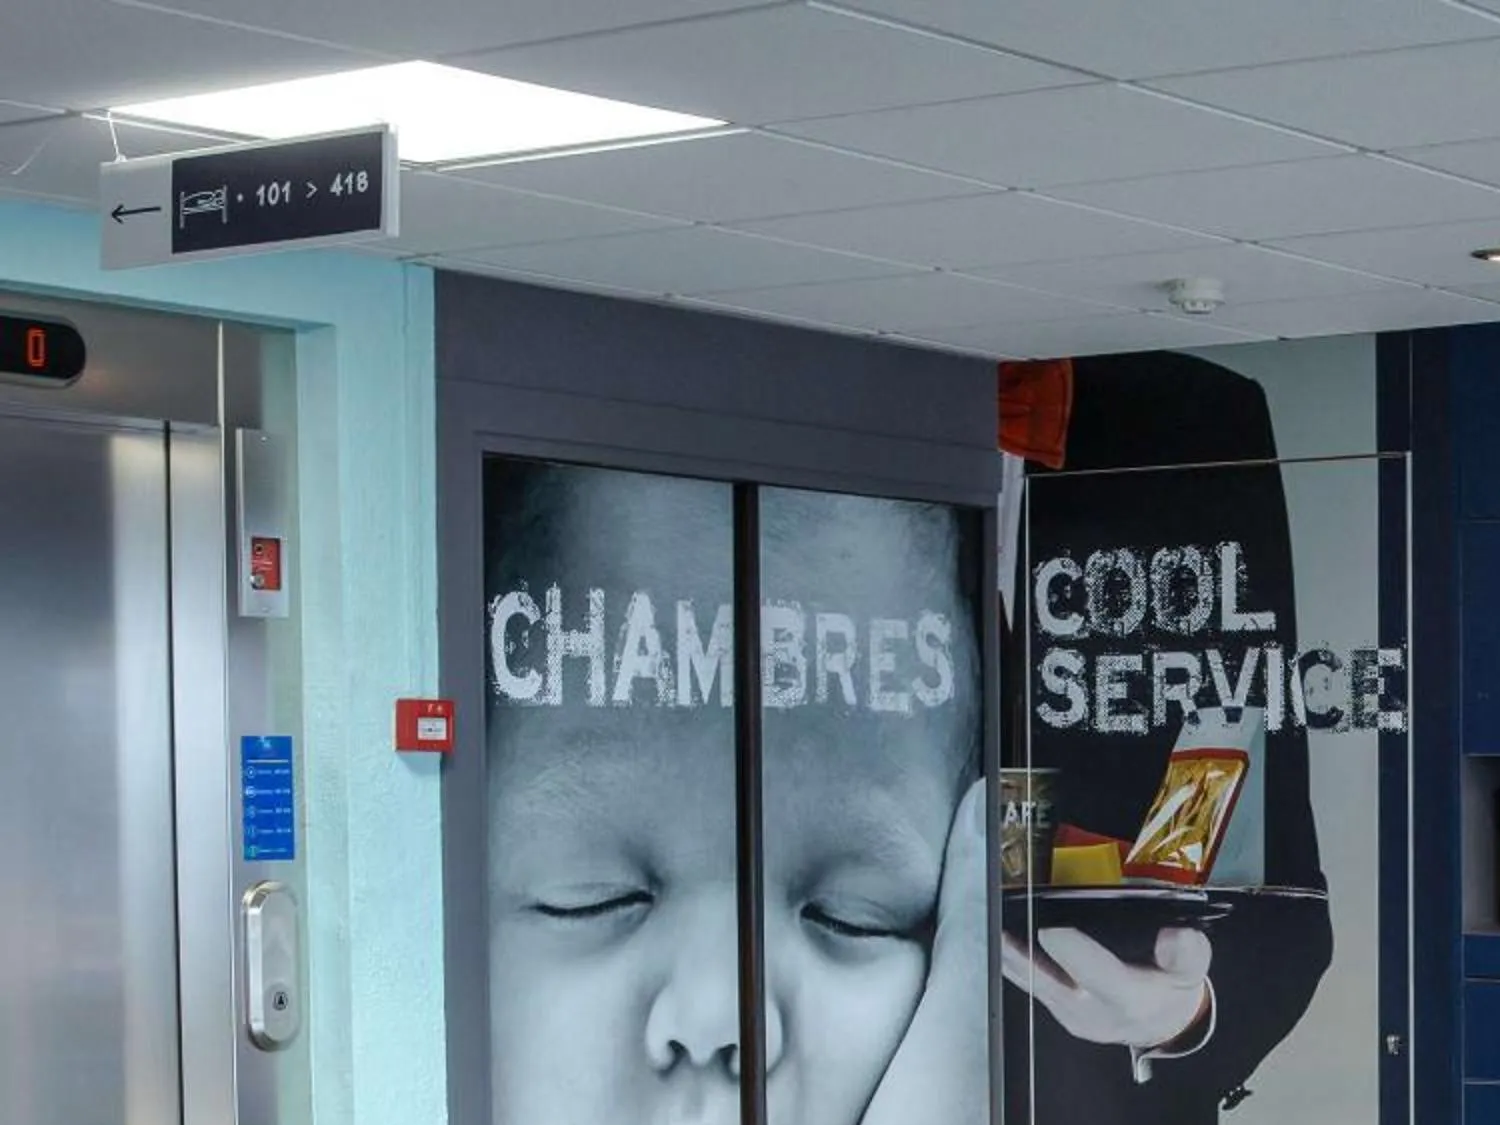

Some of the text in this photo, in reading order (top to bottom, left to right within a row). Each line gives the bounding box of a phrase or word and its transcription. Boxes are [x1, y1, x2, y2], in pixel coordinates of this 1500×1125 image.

[255, 181, 291, 206] 101
[330, 170, 369, 197] 418
[26, 328, 46, 367] 0
[1034, 541, 1276, 638] COOL
[489, 579, 956, 714] CHAMBRES
[1034, 641, 1409, 738] SERVICE
